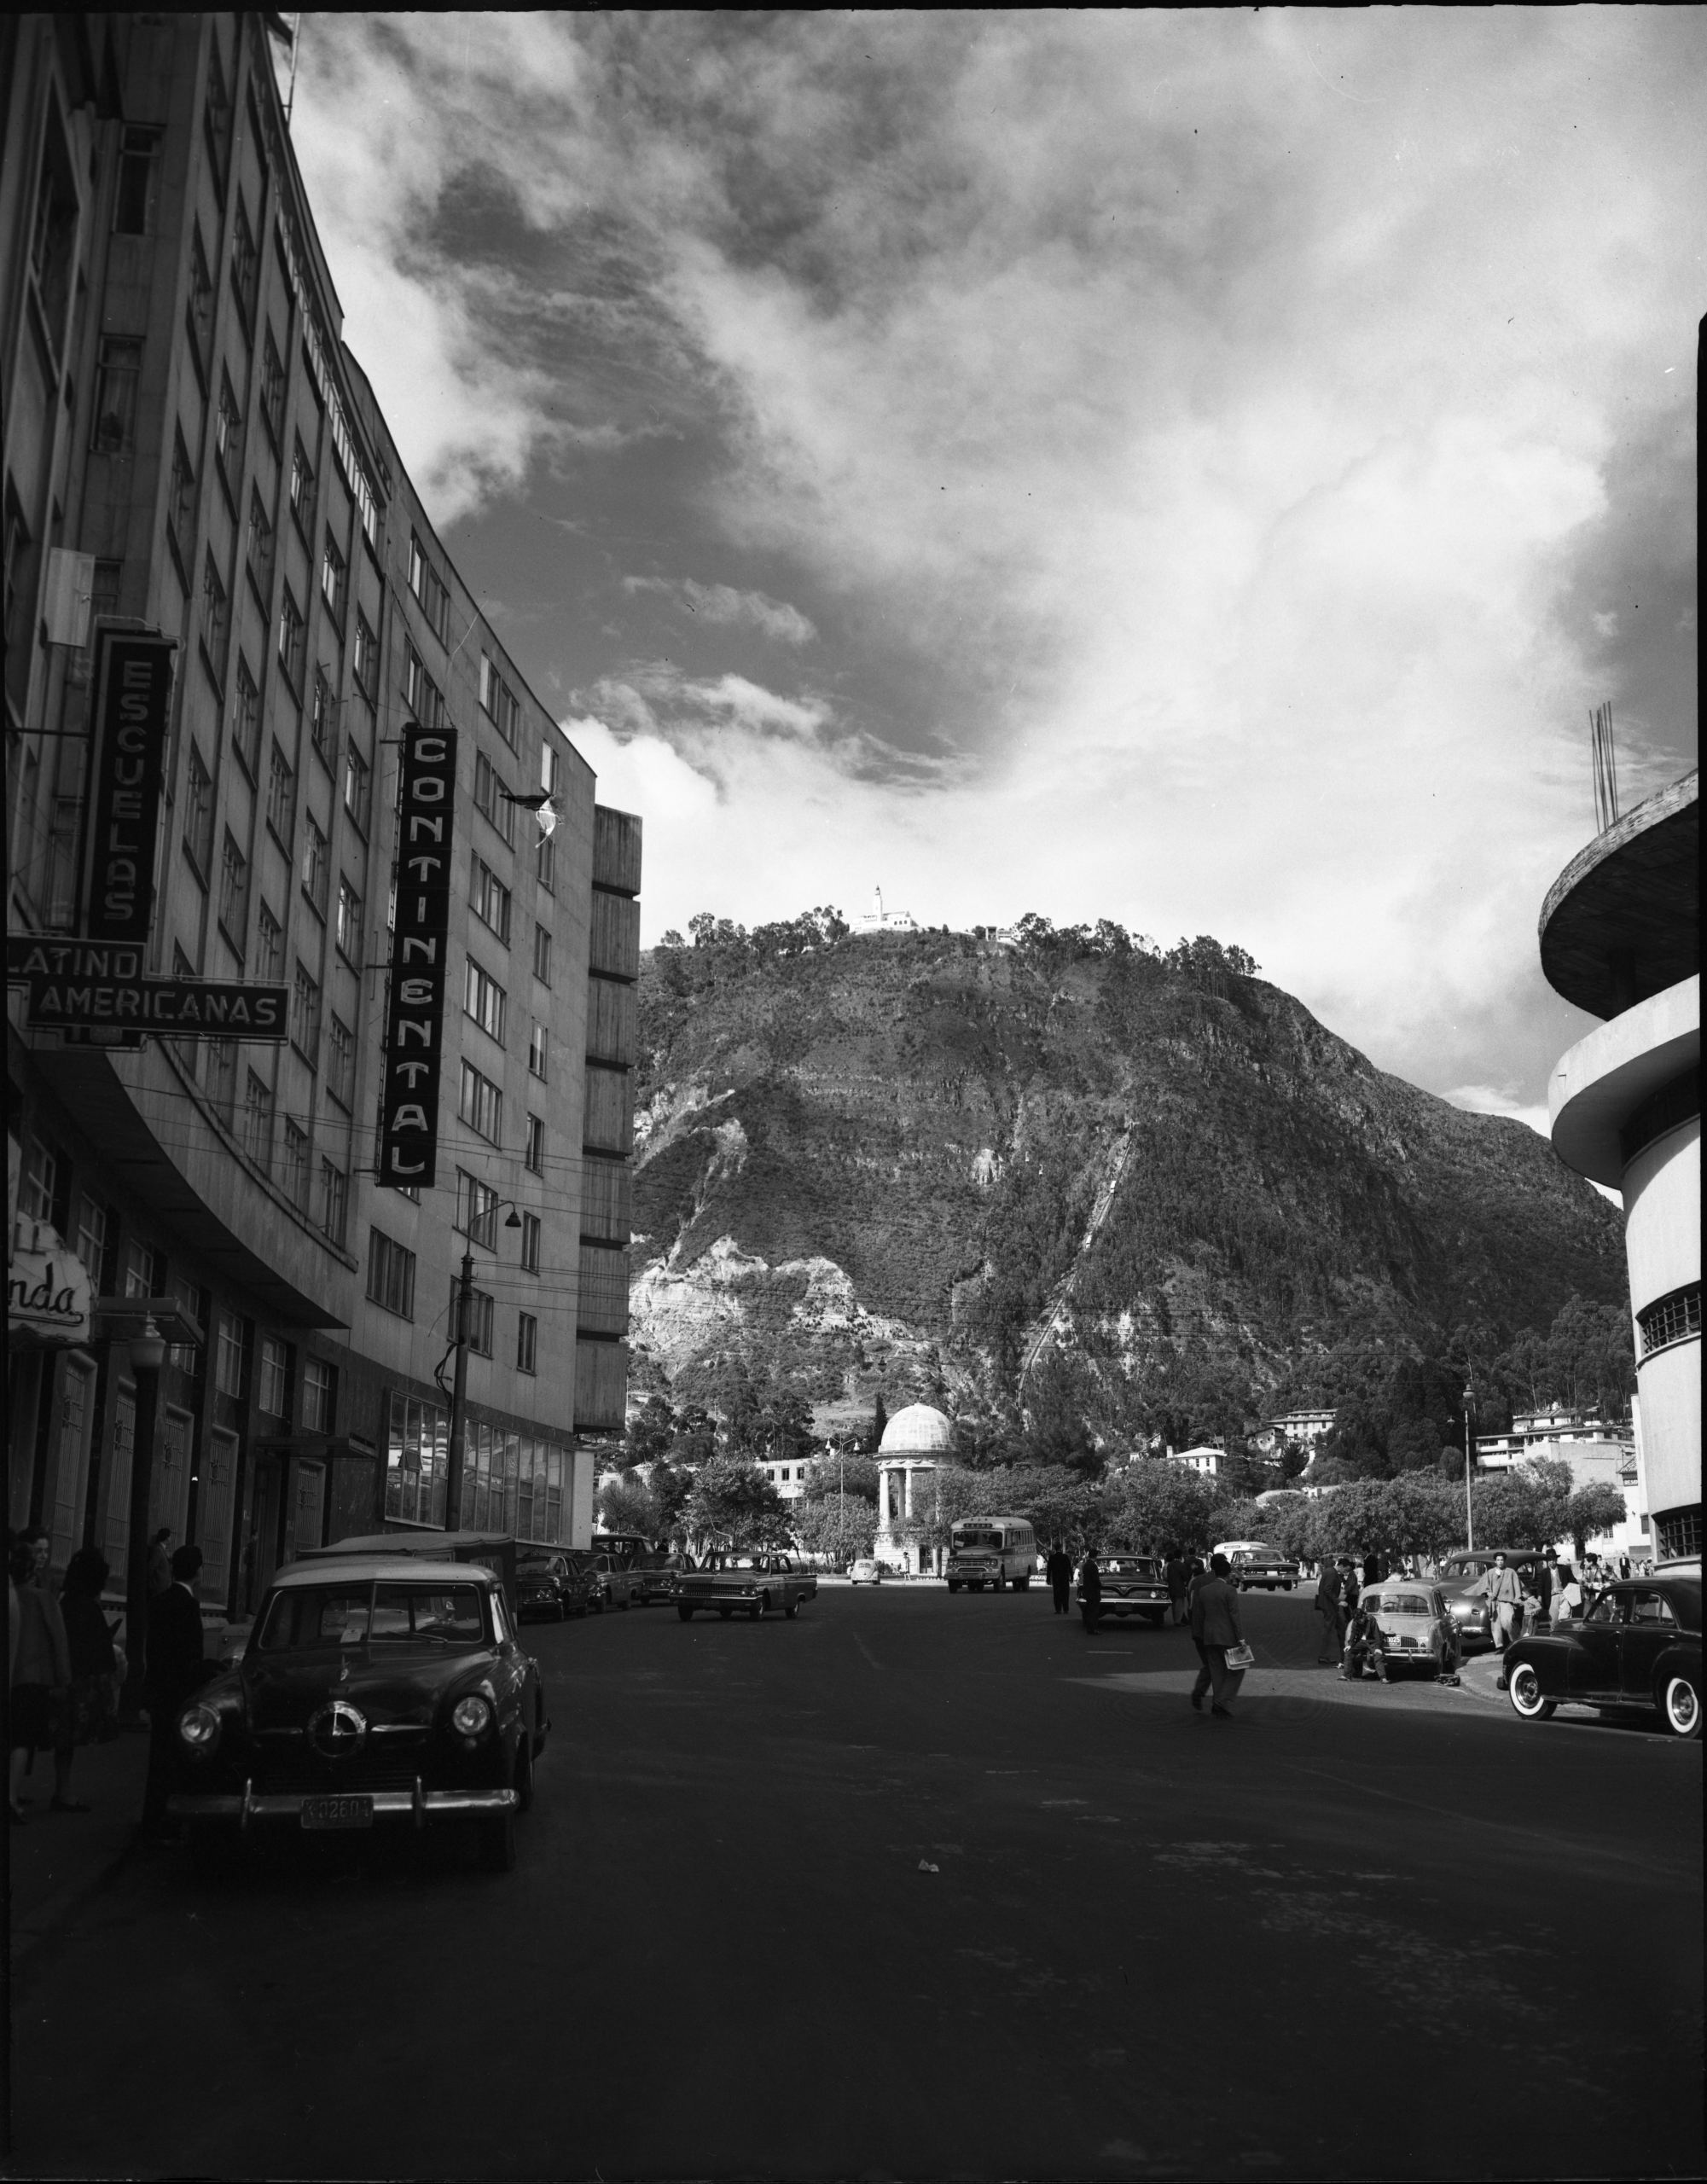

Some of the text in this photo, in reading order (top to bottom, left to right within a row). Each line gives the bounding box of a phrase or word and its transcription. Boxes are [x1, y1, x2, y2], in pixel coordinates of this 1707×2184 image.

[103, 660, 153, 920] ESCUELAS
[38, 985, 277, 1025] AMERICANAS
[391, 737, 447, 1175] CONTINENTAL
